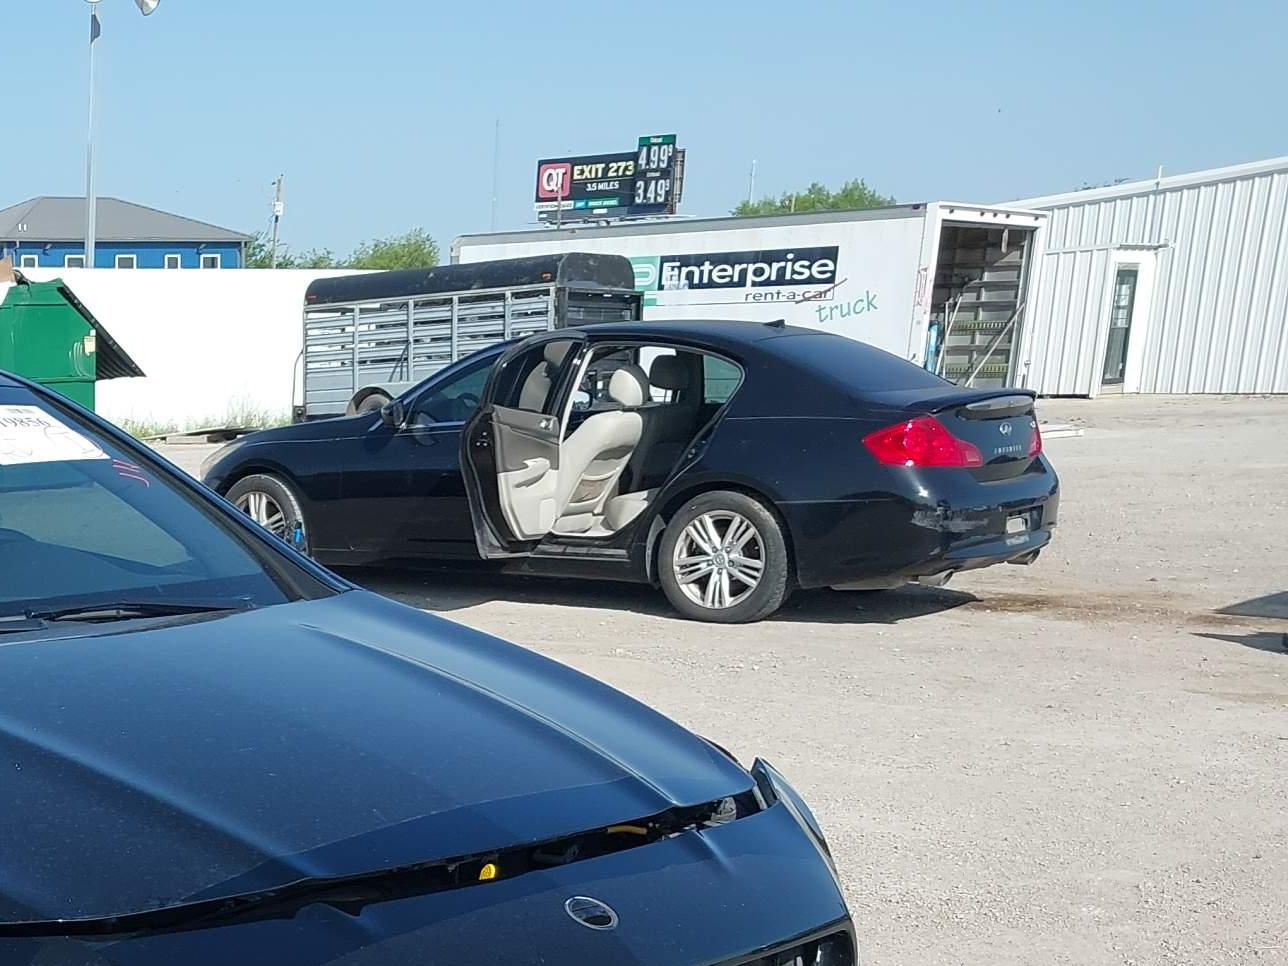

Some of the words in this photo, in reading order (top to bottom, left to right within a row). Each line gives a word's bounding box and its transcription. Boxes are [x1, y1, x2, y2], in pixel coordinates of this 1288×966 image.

[542, 168, 566, 192] QT
[573, 163, 605, 180] EXIT
[607, 161, 634, 177] 273
[597, 181, 619, 190] MILES
[661, 253, 835, 289] Enterprise
[744, 288, 830, 302] rent-a-car
[815, 290, 879, 322] truck
